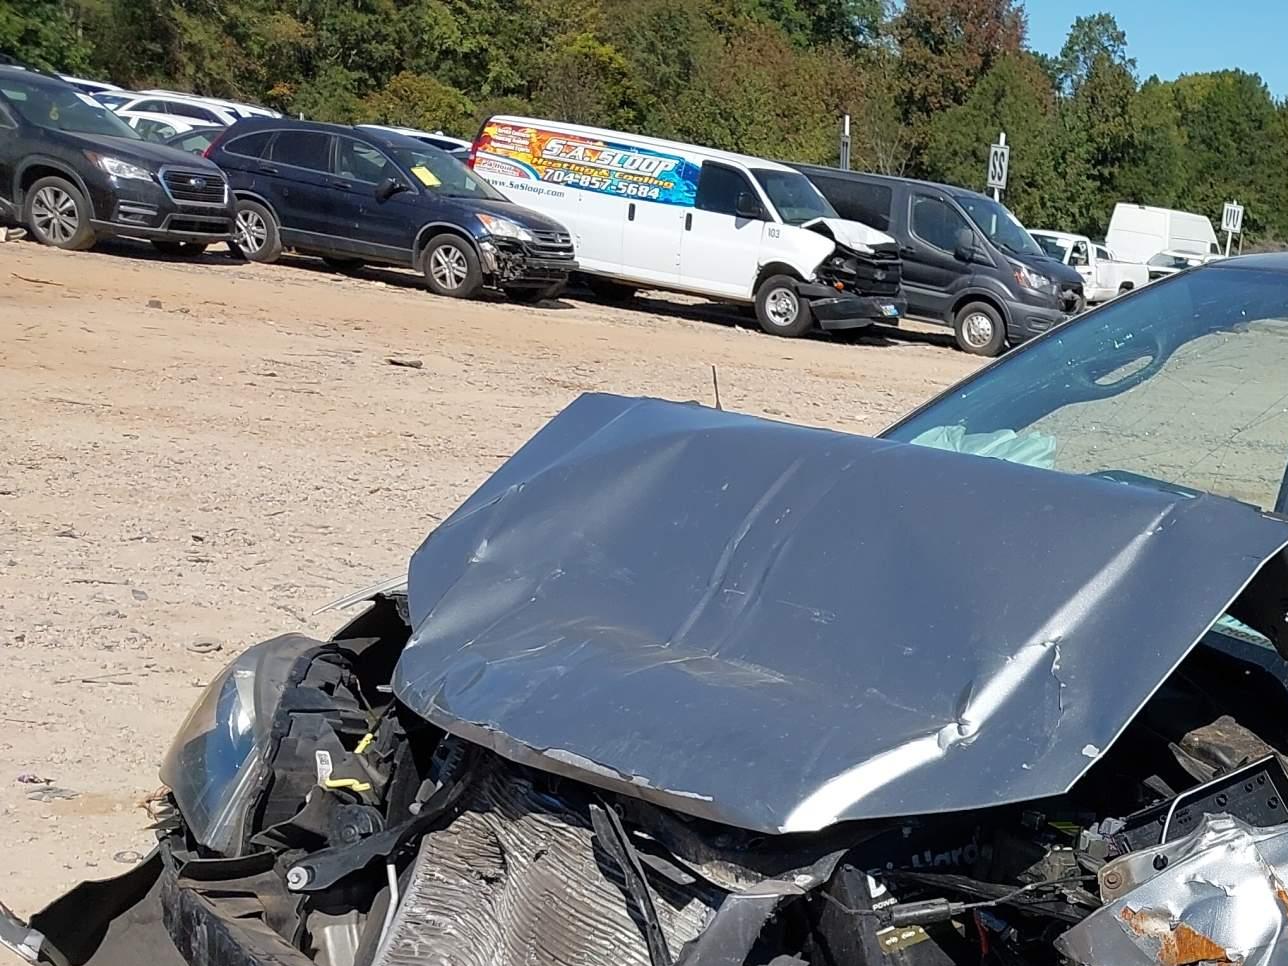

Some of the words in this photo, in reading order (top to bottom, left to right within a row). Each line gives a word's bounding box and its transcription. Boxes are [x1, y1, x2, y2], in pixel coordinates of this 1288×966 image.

[532, 157, 595, 177] Heating
[596, 168, 609, 178] &
[614, 171, 675, 189] Cooling
[543, 138, 592, 160] S.A.
[594, 151, 679, 178] SLOOP
[991, 150, 1005, 182] SS
[543, 169, 660, 200] 704-857-5684
[768, 228, 780, 239] 103
